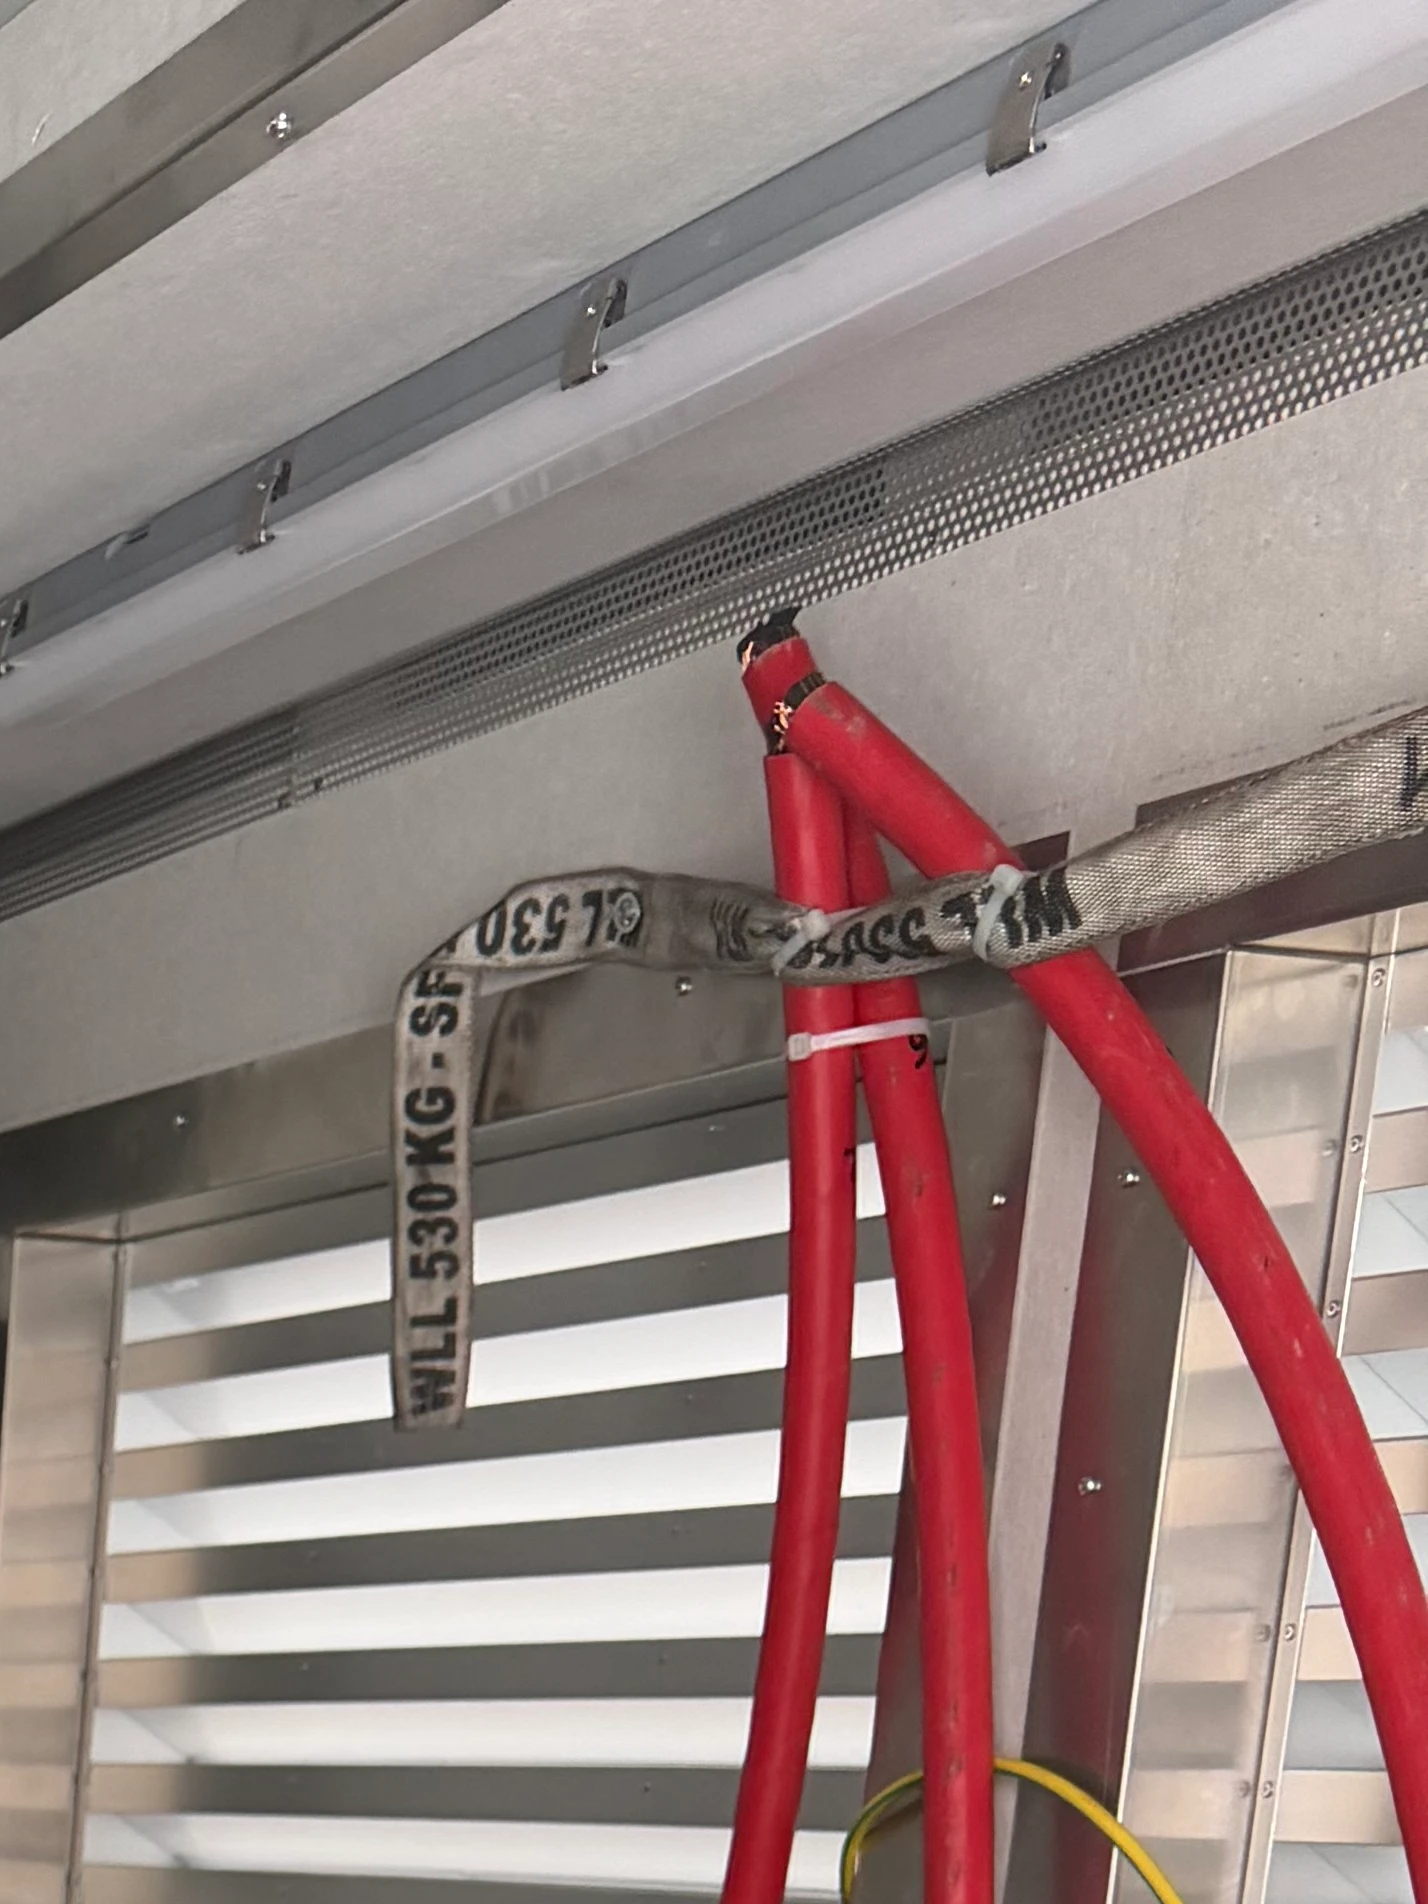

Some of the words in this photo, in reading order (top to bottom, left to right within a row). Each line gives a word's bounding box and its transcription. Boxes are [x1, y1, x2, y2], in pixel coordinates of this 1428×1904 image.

[477, 894, 571, 958] 530
[408, 968, 464, 1037] SF
[404, 1086, 456, 1166] KG
[407, 1182, 460, 1280] 530
[409, 1296, 459, 1417] WLL
